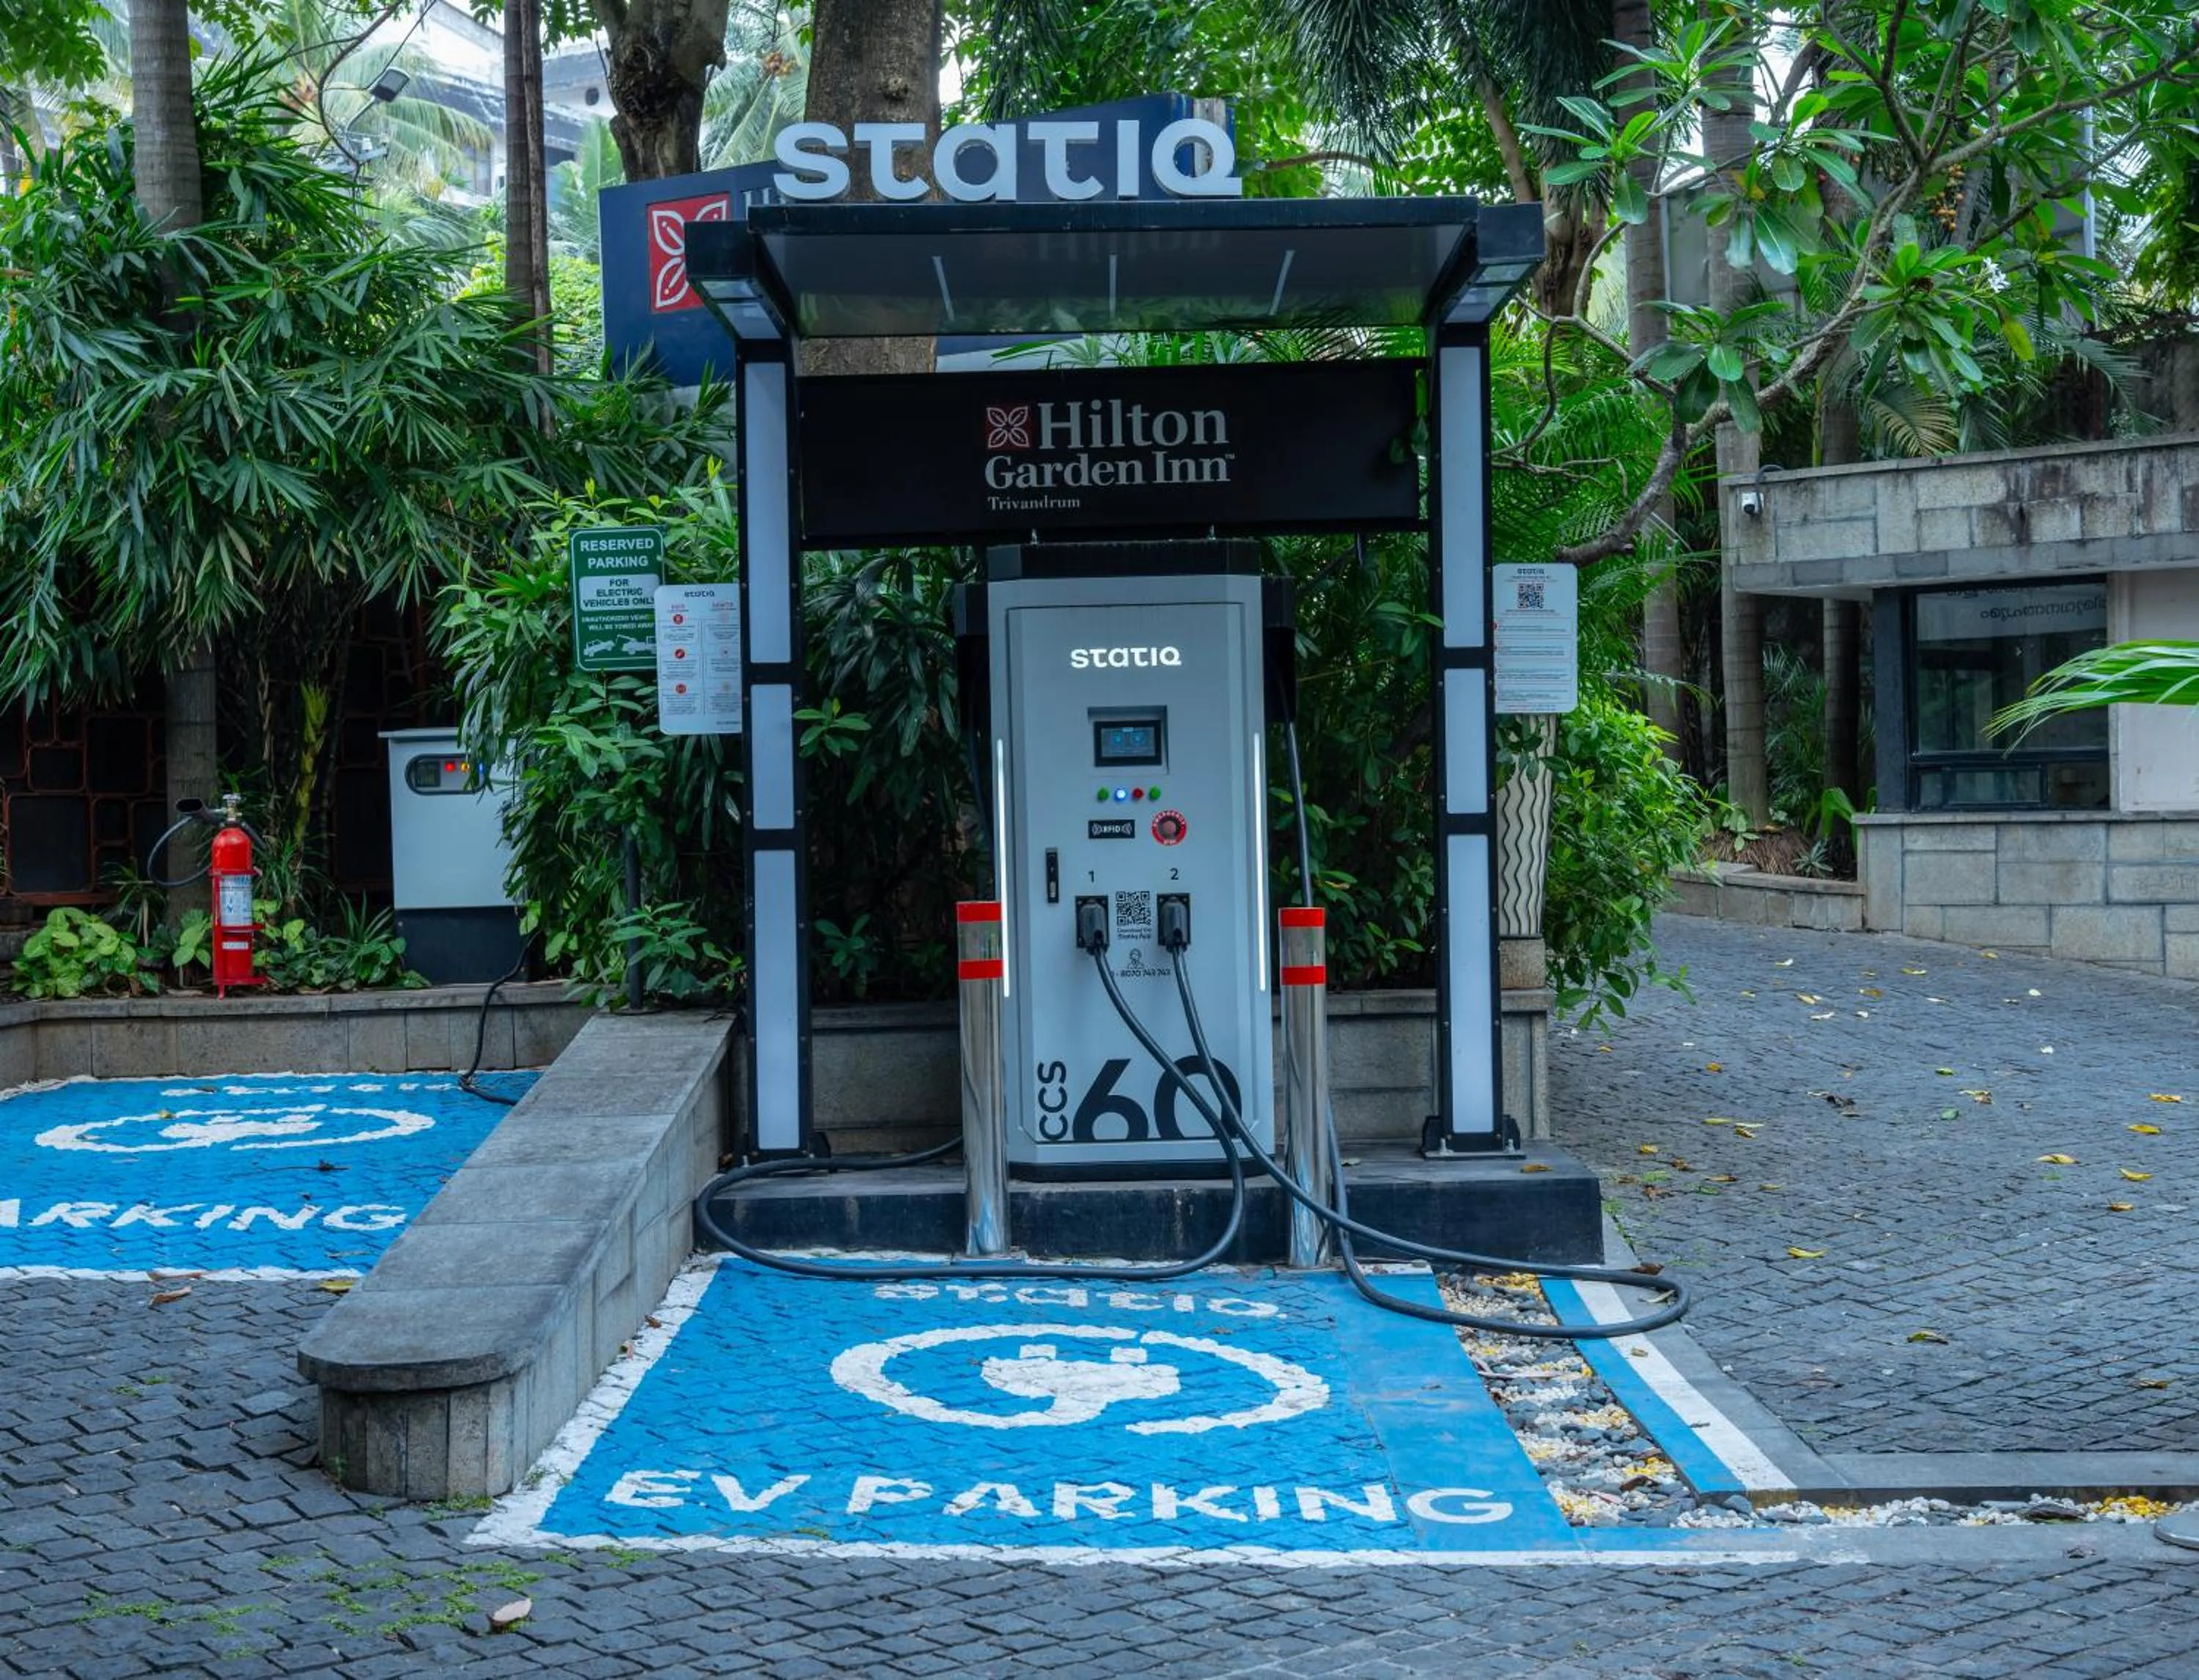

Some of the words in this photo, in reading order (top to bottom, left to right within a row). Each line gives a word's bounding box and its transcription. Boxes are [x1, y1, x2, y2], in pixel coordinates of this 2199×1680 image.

[1037, 399, 1229, 449] Hilton
[984, 453, 1146, 490] Garden
[987, 495, 1080, 510] Trivandrum
[580, 538, 655, 552] RESERVED
[587, 555, 649, 570] PARKING
[609, 578, 629, 587] FOR
[596, 587, 643, 597] ELECTRIC
[582, 597, 630, 608] VEHICLES
[1088, 870, 1095, 883] 1
[1170, 867, 1179, 880] 2
[1037, 1061, 1068, 1140] CCS
[1072, 1055, 1242, 1141] 60
[603, 1468, 812, 1513] EV
[846, 1473, 1514, 1525] PARKING
